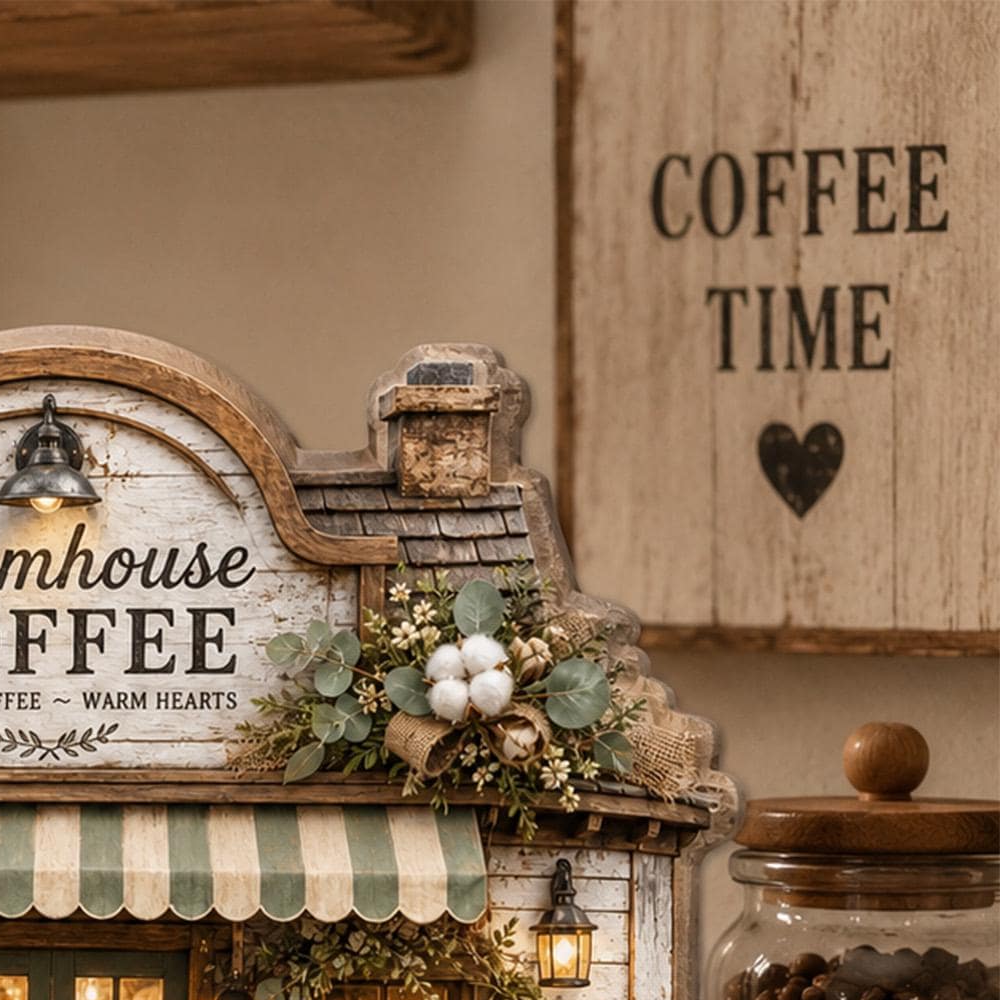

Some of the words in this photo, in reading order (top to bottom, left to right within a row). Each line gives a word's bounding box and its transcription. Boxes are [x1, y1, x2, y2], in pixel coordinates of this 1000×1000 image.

[650, 144, 949, 240] COFFEE
[705, 284, 891, 372] TIME
[82, 691, 149, 711] WARM
[155, 691, 238, 711] HEARTS
